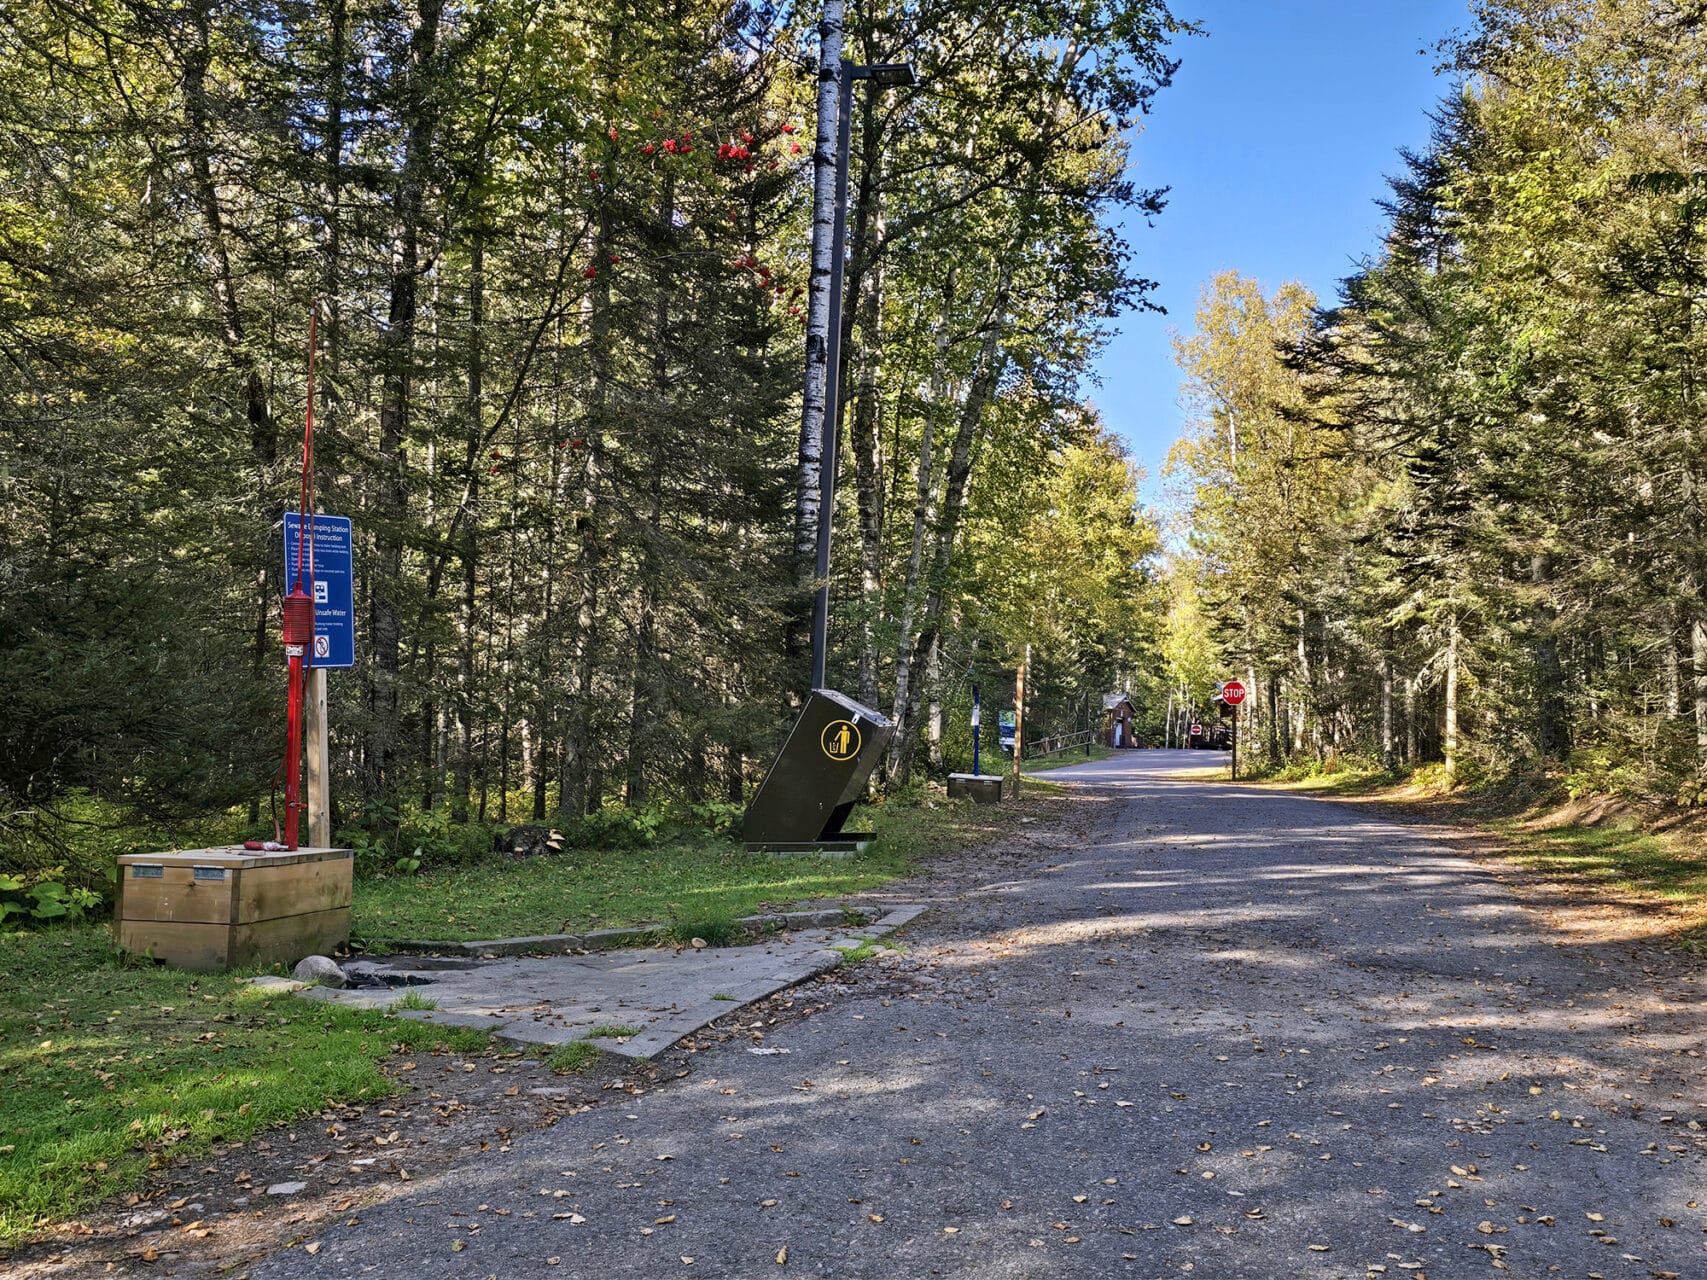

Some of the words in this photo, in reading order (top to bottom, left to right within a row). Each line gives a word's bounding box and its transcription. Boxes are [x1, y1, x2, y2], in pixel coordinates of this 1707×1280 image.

[287, 521, 307, 530] Sewae
[308, 522, 331, 533] Dmping
[331, 525, 349, 533] Station
[316, 533, 343, 542] Instruction
[331, 609, 347, 617] Water
[1224, 688, 1245, 698] STOP
